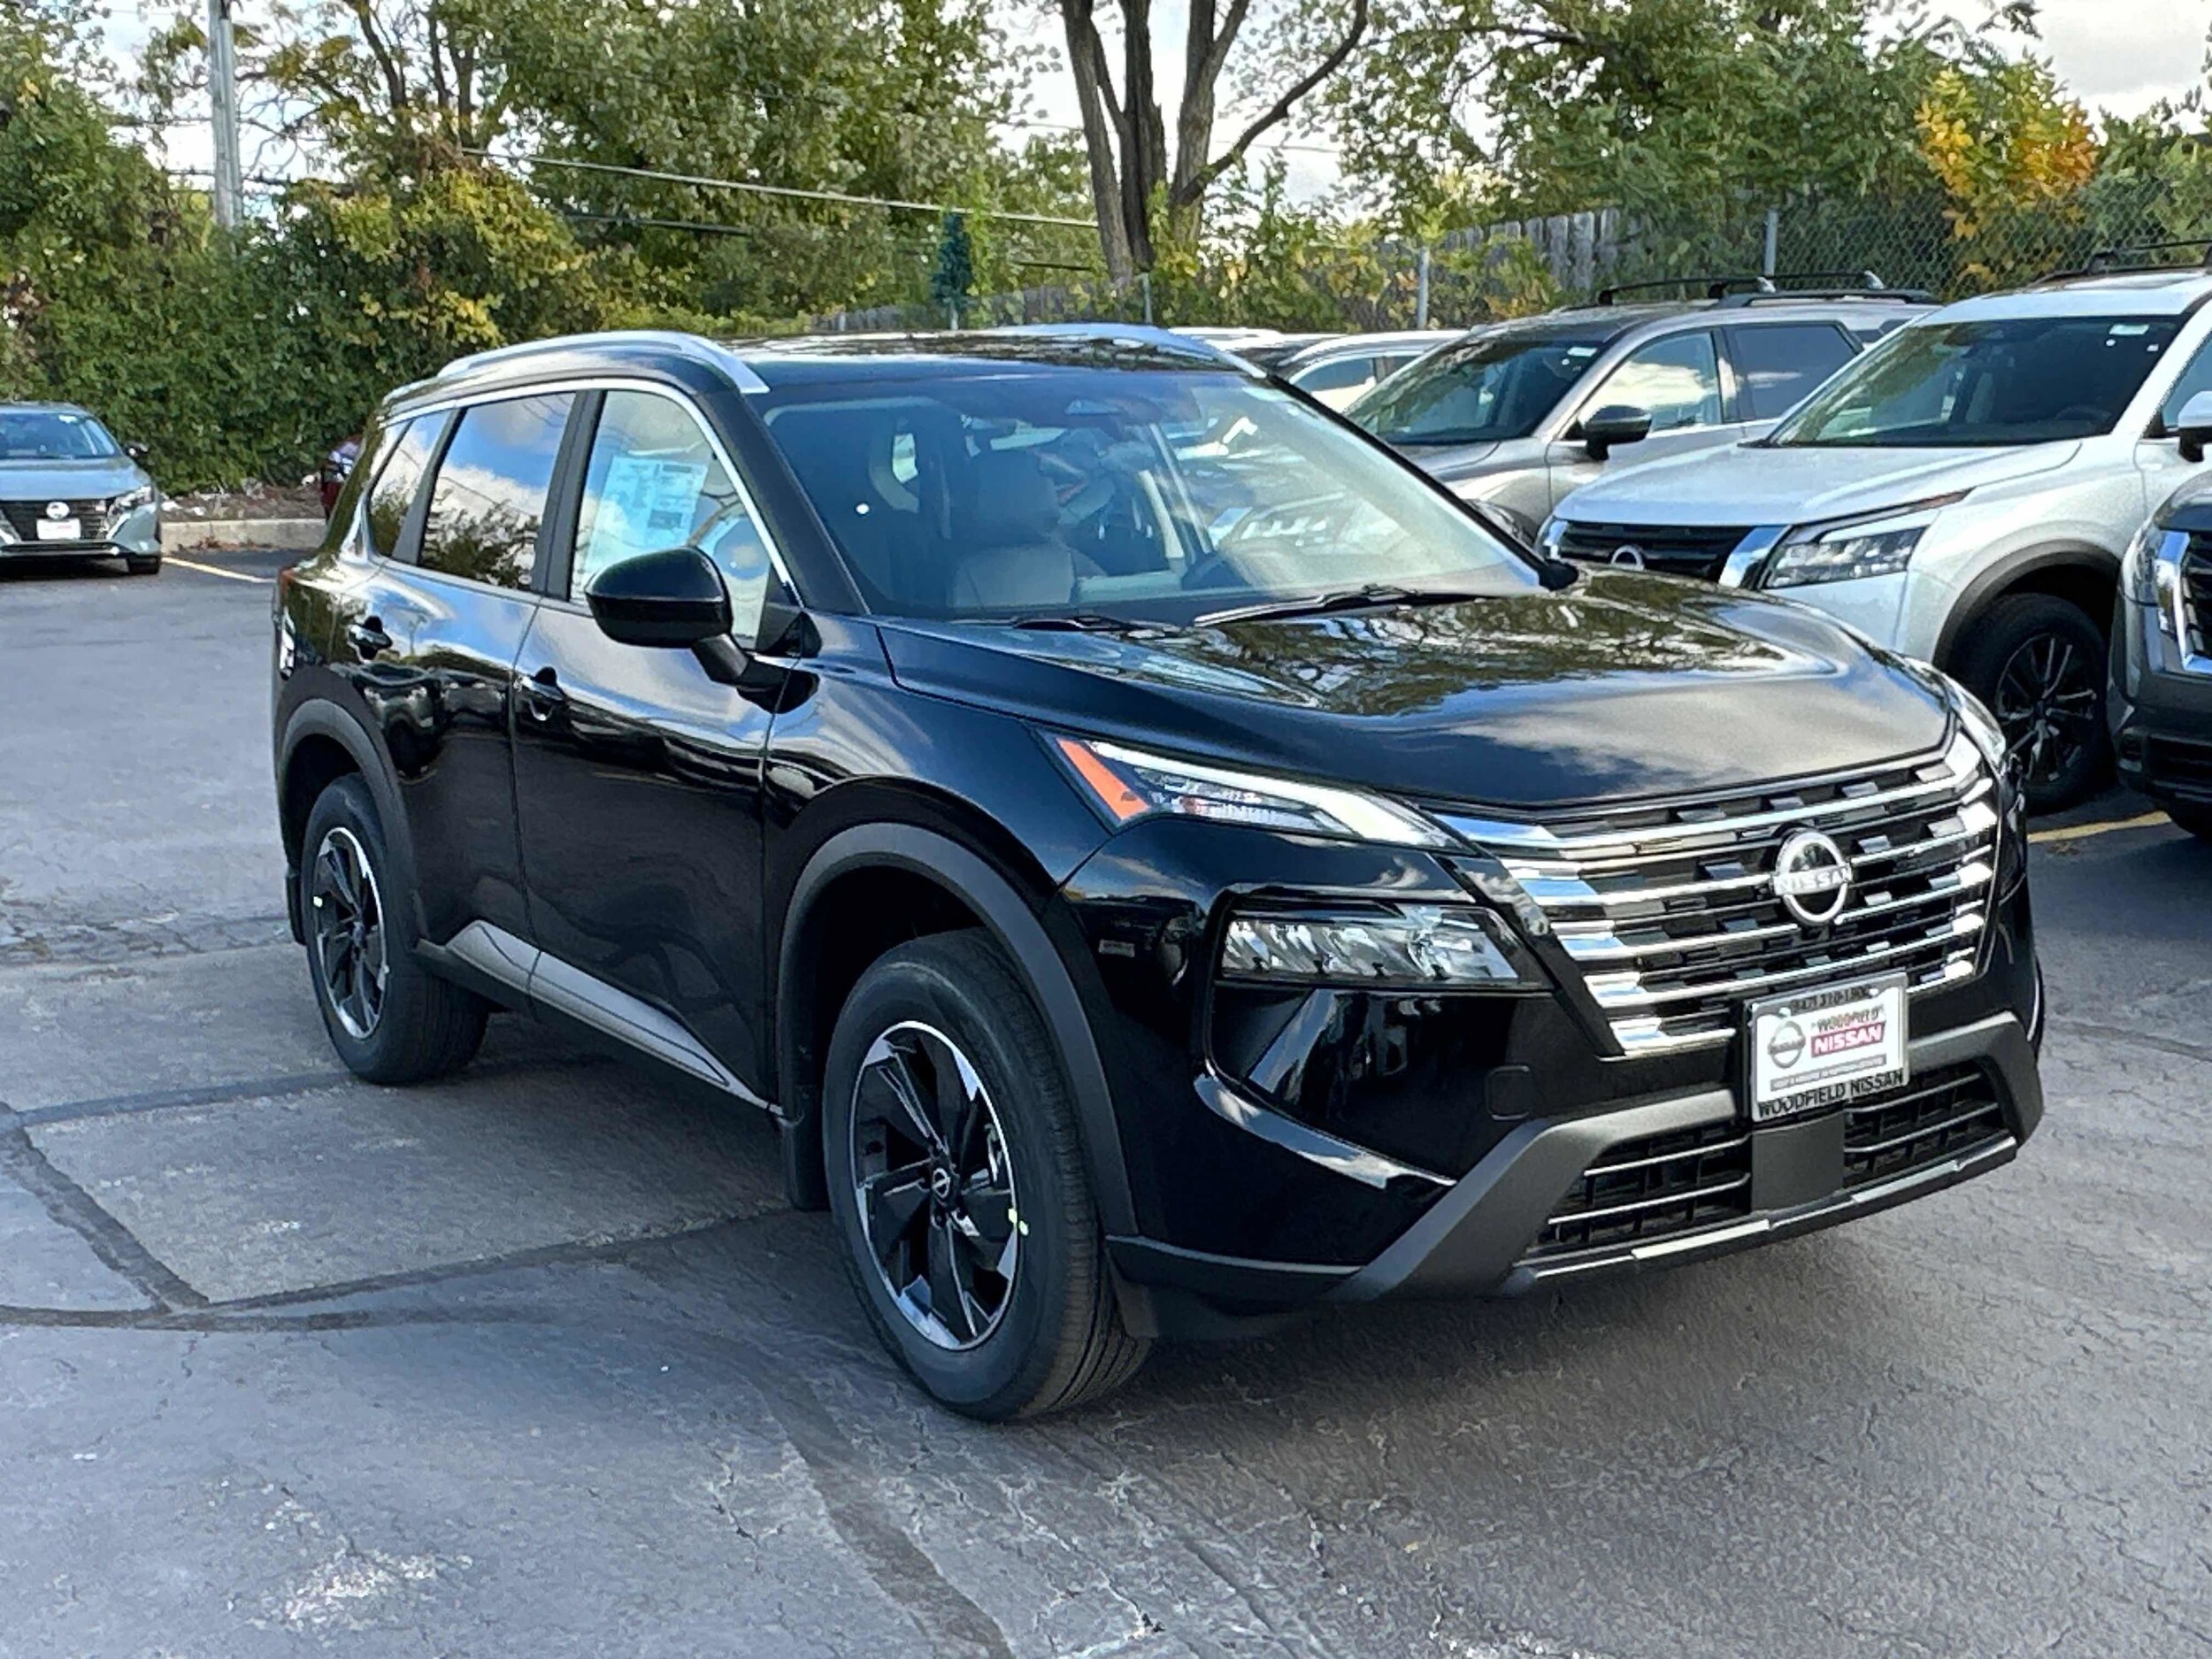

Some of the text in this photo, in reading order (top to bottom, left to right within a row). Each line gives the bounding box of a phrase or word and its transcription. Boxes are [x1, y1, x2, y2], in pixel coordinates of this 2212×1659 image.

[1778, 868, 1851, 892] NISSAN
[1814, 1024, 1881, 1054] NISSAN
[1757, 1083, 1846, 1117] WOODFIELD
[1850, 1069, 1903, 1094] NISSAN
